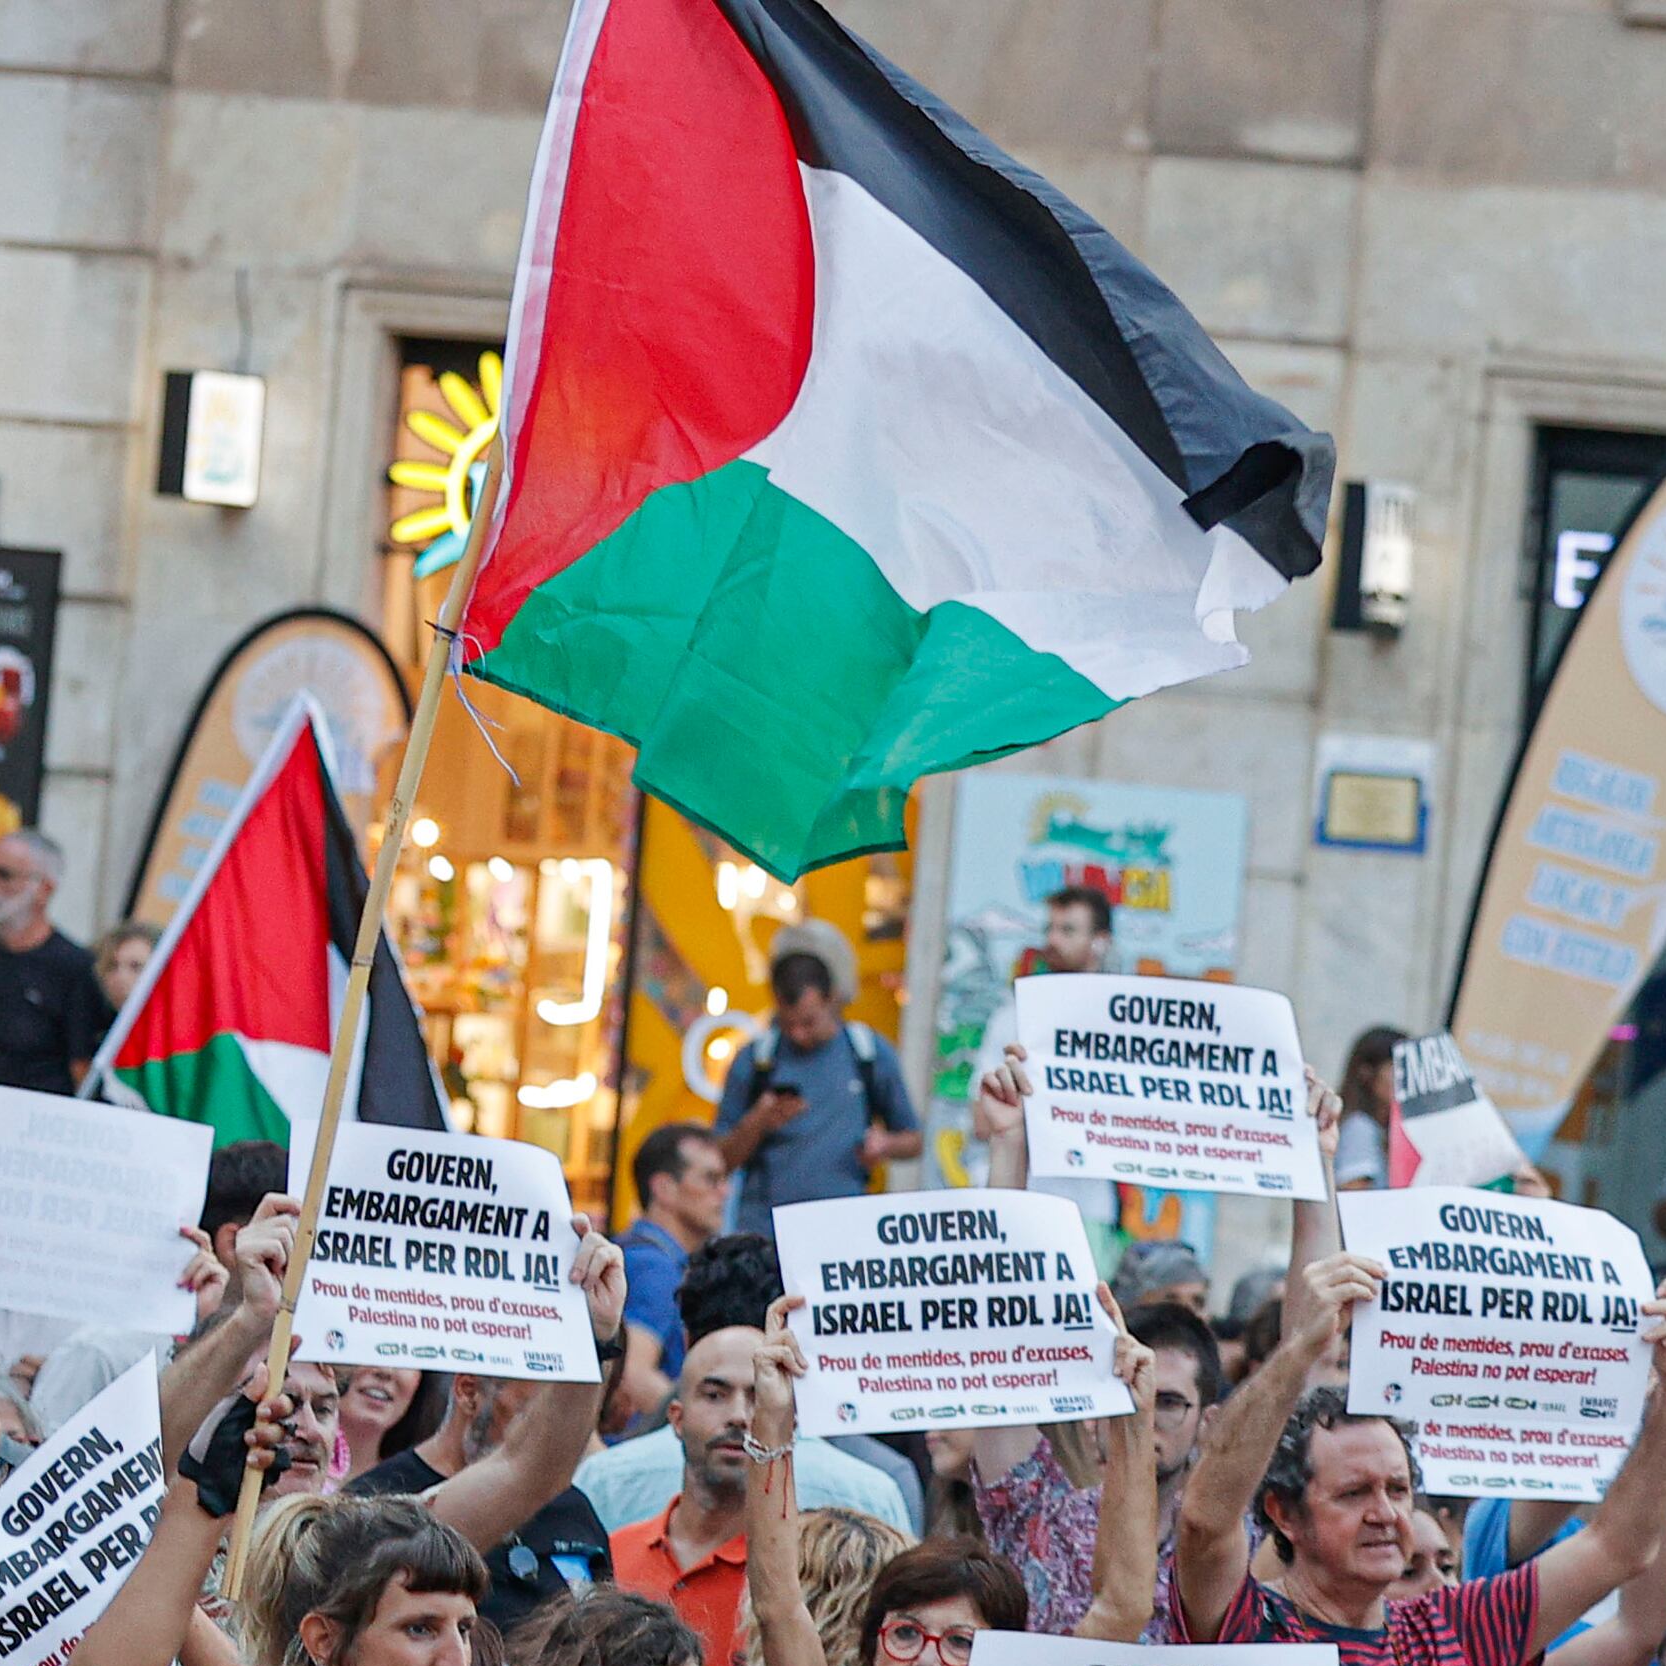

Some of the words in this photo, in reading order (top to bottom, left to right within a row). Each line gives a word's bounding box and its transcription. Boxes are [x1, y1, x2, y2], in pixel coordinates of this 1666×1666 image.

[1109, 994, 1221, 1035] GOVERN,
[1055, 1029, 1255, 1076] EMBARGAMENT
[1261, 1049, 1278, 1077] A
[1046, 1066, 1134, 1098] ISRAEL
[1141, 1077, 1193, 1103] PER
[1200, 1083, 1250, 1110] RDL
[1258, 1087, 1292, 1115] JA!
[386, 1148, 498, 1195] GOVERN,
[325, 1187, 524, 1240] EMBARGAMENT
[531, 1209, 550, 1242] A
[877, 1209, 1007, 1244] GOVERN,
[1439, 1204, 1553, 1245] GOVERN,
[310, 1229, 397, 1269] ISRAEL
[405, 1237, 455, 1275] PER
[464, 1246, 516, 1282] RDL
[521, 1252, 560, 1287] JA!
[820, 1252, 1046, 1291] EMBARGAMENT
[1056, 1252, 1075, 1281] A
[1388, 1243, 1595, 1283] EMBARGAMENT
[1603, 1261, 1621, 1286] A
[813, 1301, 912, 1335] ISRAEL
[921, 1299, 977, 1330] PER
[988, 1296, 1043, 1328] RDL
[1052, 1293, 1092, 1325] JA!
[1381, 1281, 1472, 1316] ISRAEL
[1481, 1286, 1533, 1320] PER
[1542, 1292, 1593, 1324] RDL
[1601, 1296, 1638, 1327] JA!
[1, 1426, 124, 1538] GOVERN,
[79, 1521, 149, 1584] PER
